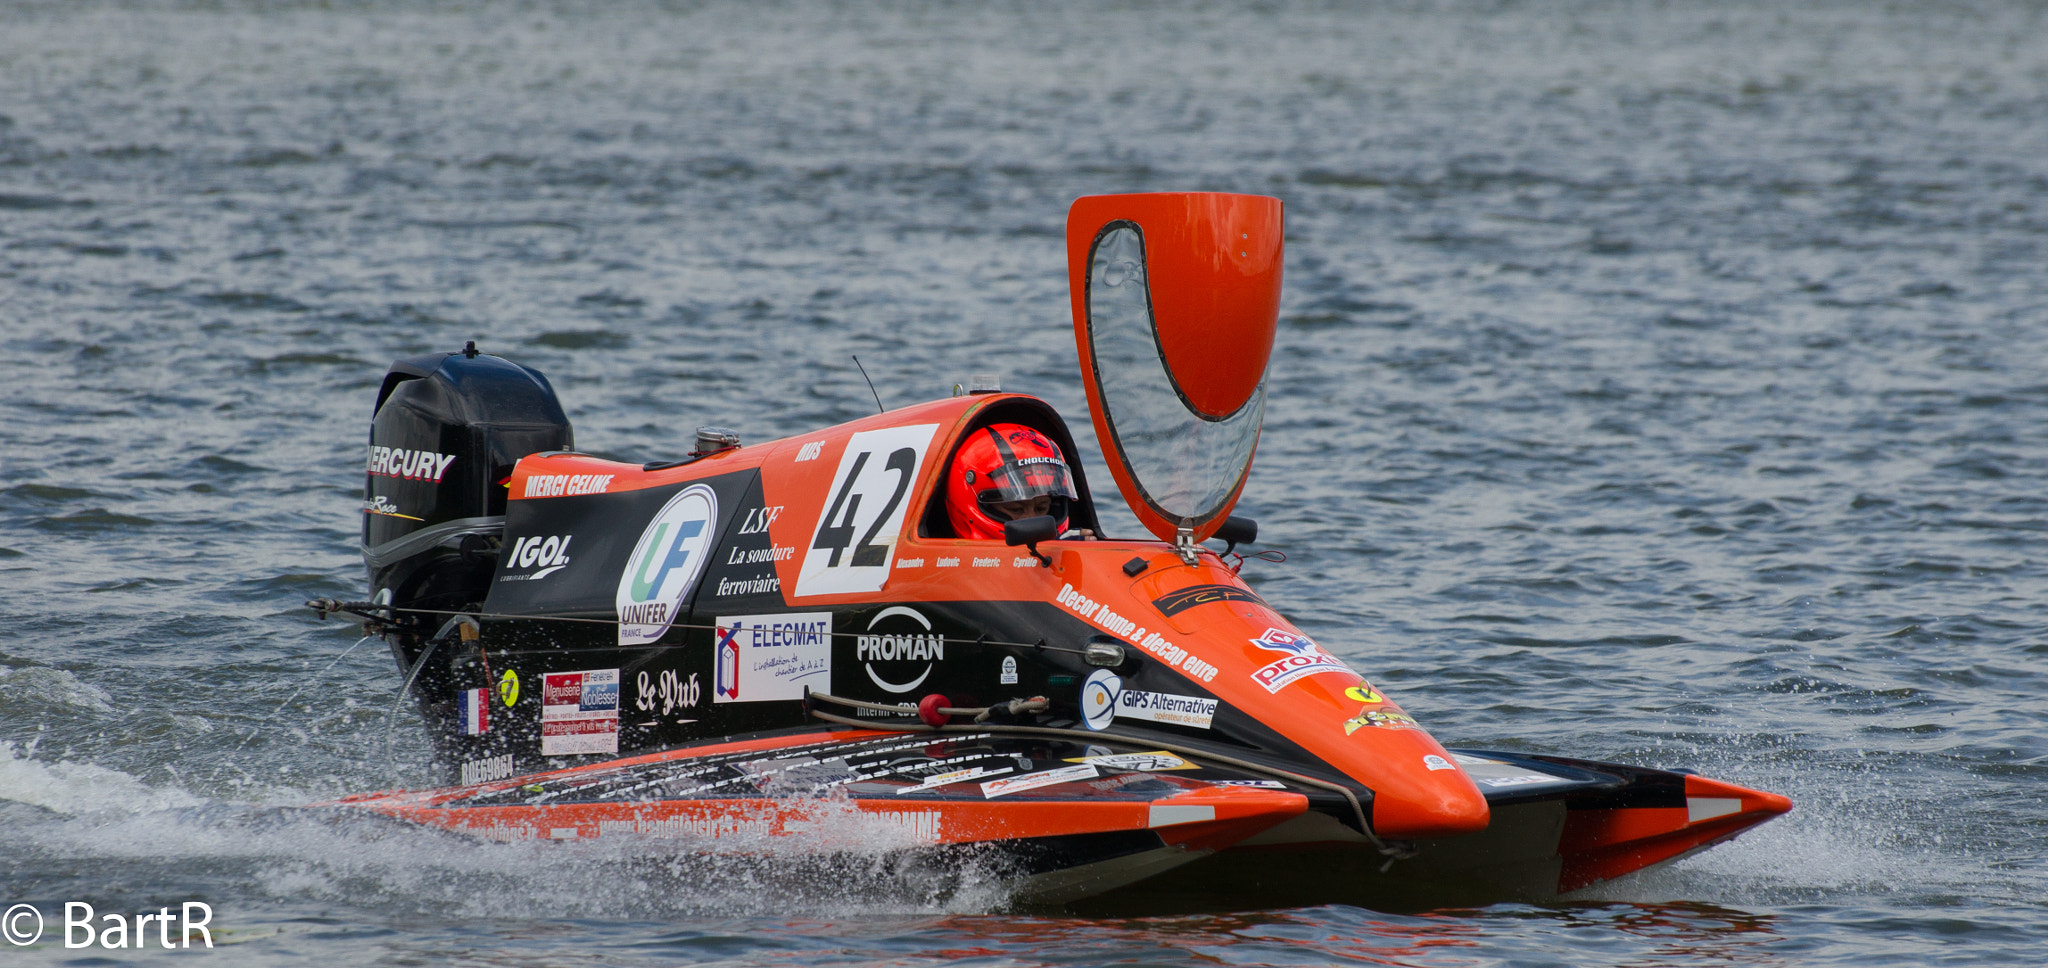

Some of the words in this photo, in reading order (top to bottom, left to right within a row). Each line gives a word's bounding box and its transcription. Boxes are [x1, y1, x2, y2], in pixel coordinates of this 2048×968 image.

[795, 440, 825, 462] MDS
[525, 476, 568, 497] MERCI
[567, 474, 615, 494] CELINE
[812, 447, 917, 567] 42
[738, 506, 784, 534] LSF
[727, 546, 745, 565] La
[746, 543, 795, 564] soudure
[896, 558, 924, 569] Alexandre
[936, 556, 960, 568] Ludovic
[972, 557, 1000, 568] Frederic
[1013, 557, 1037, 568] Cyrille
[716, 573, 781, 596] ferroviaire
[622, 603, 667, 625] UNIFER
[621, 629, 642, 638] FRANCE
[753, 621, 826, 648] ELECMAT
[1055, 583, 1100, 618] Decor
[1093, 604, 1136, 637] home
[1129, 627, 1146, 642] &
[1140, 632, 1188, 666] decap
[1182, 655, 1219, 683] eure
[857, 634, 944, 661] PROMAN
[807, 659, 813, 670] A
[582, 689, 616, 706] Noblesse
[636, 671, 656, 711] Le
[658, 669, 700, 716] Pub
[1123, 690, 1149, 708] GIPS
[1150, 693, 1215, 715] Alternative
